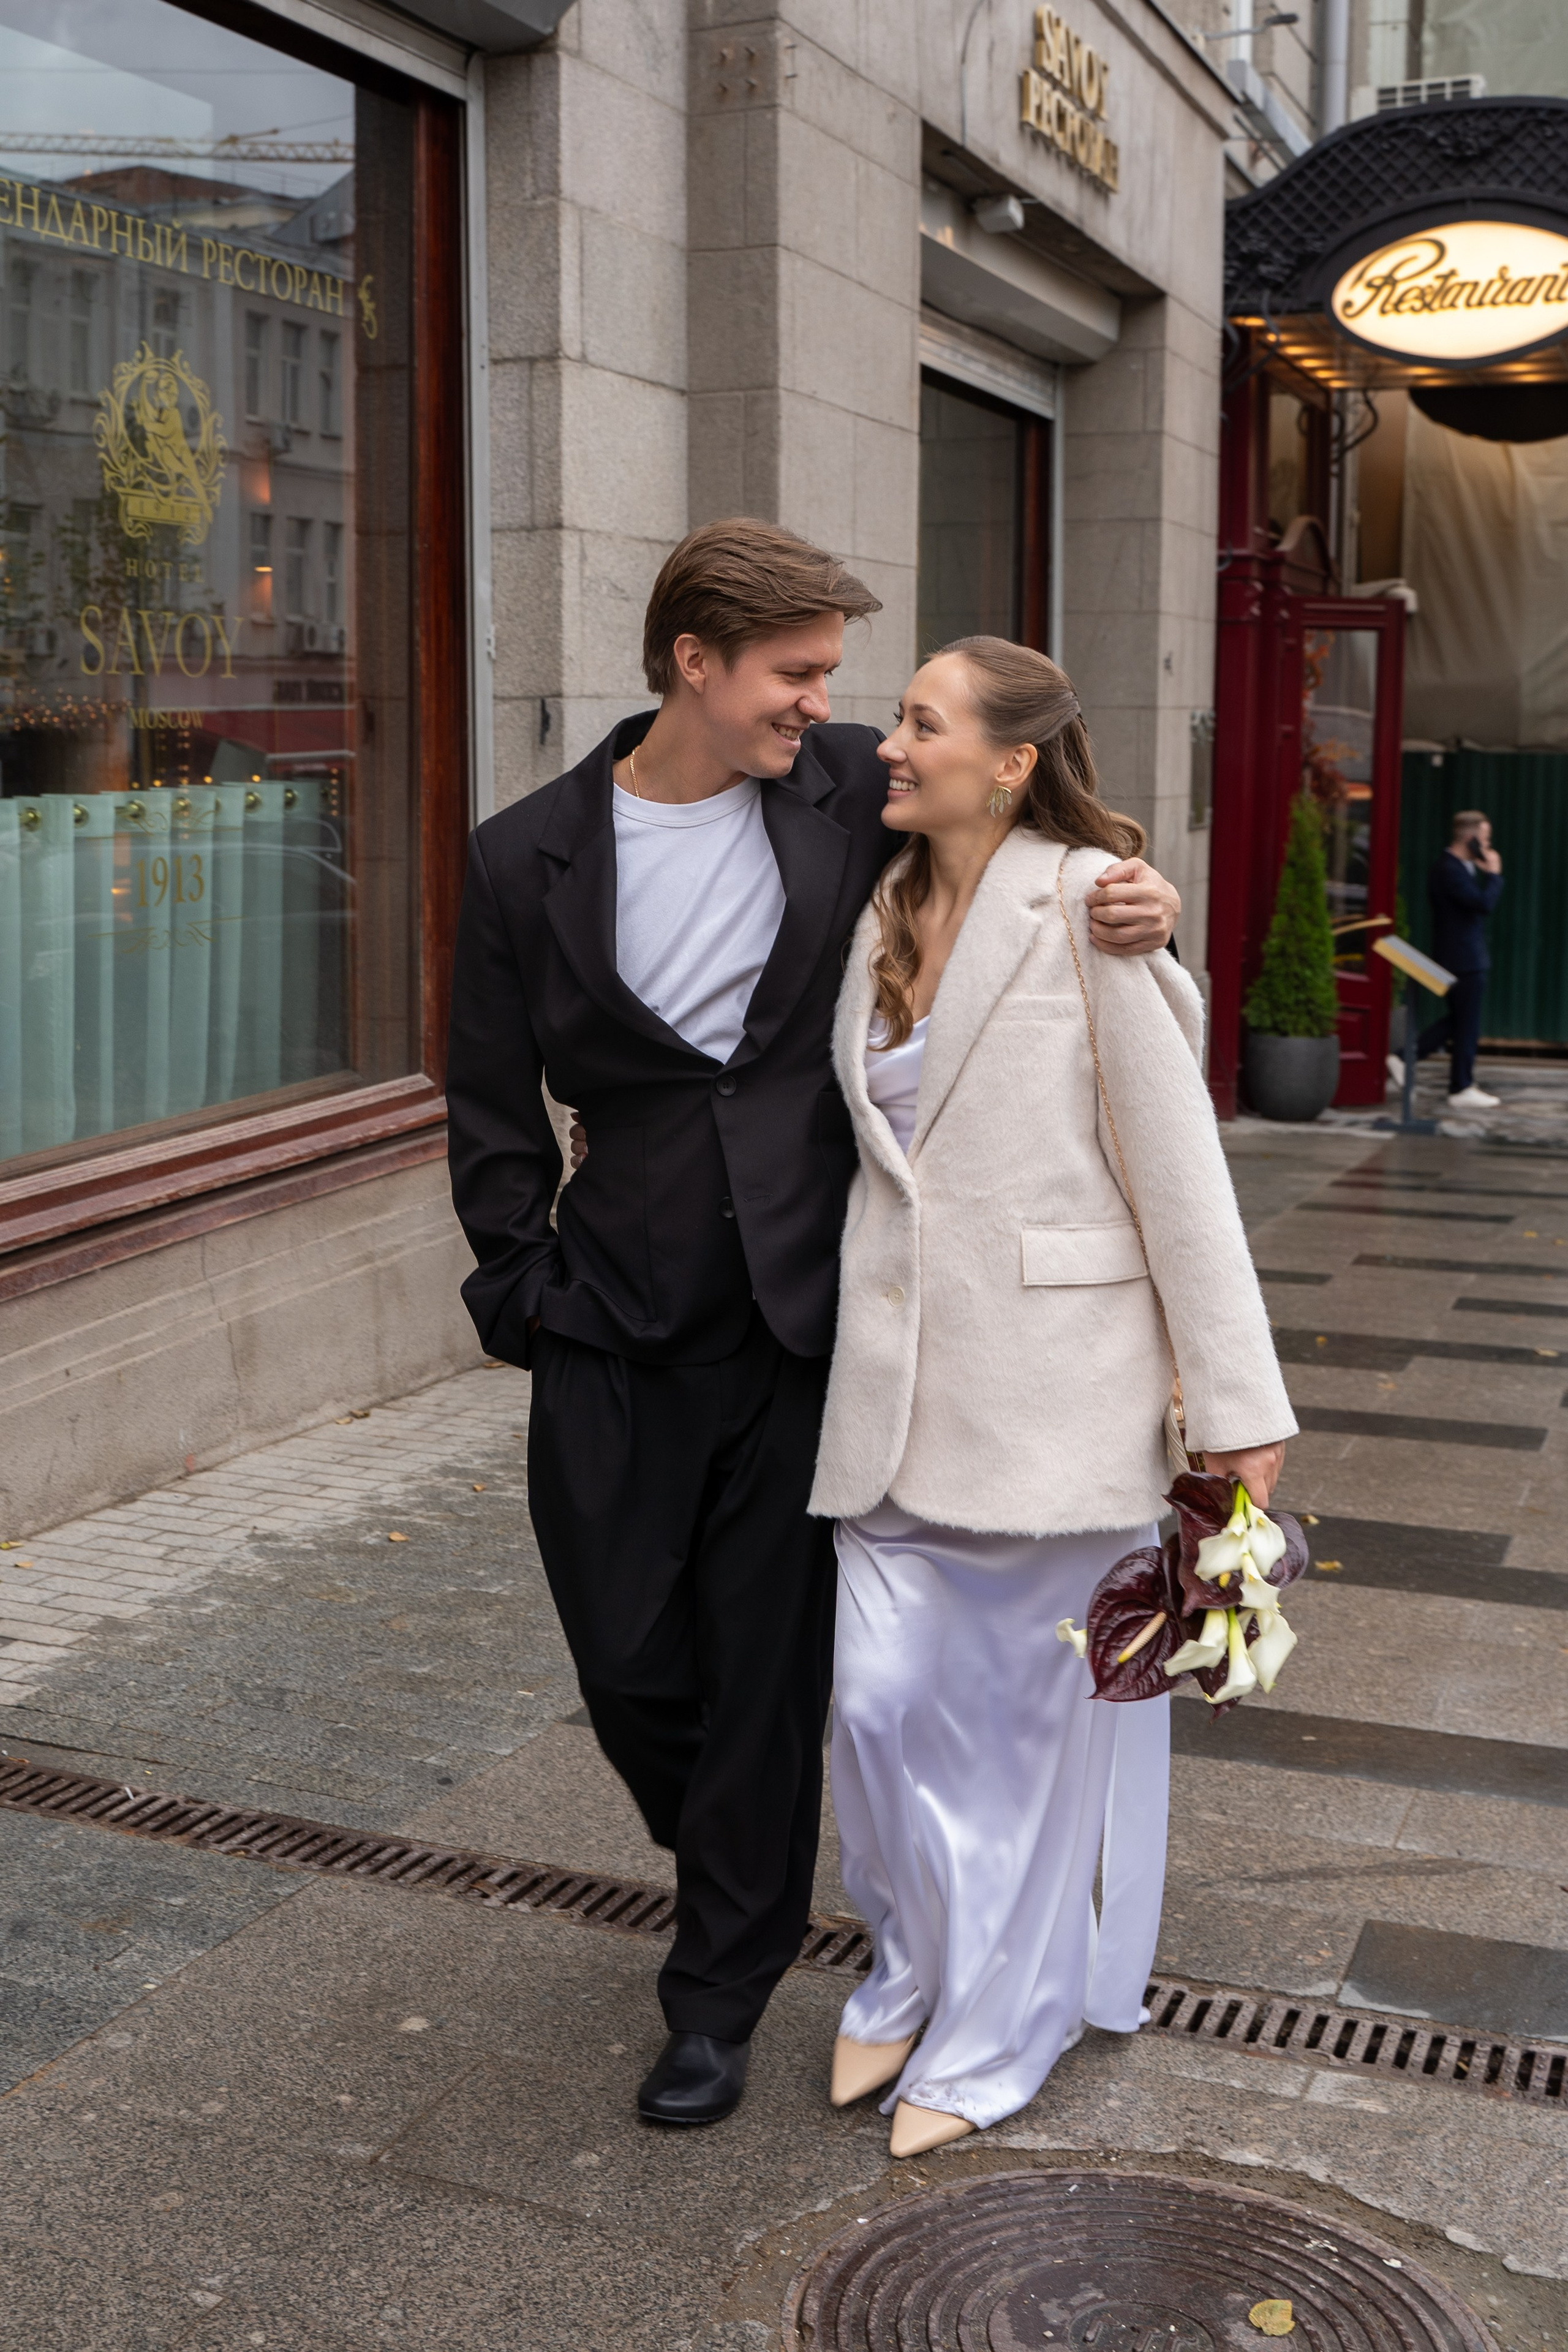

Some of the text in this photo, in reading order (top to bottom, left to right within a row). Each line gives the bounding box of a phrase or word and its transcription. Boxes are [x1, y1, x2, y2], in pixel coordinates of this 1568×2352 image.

[1035, 3, 1109, 122] SAVOY
[202, 237, 345, 317] РЕСТОРАН
[1341, 238, 1568, 318] Restaurant
[125, 557, 205, 583] HOTEL
[80, 605, 245, 679] SAVOY
[126, 707, 203, 729] MOSCOW
[135, 853, 205, 907] 1913
